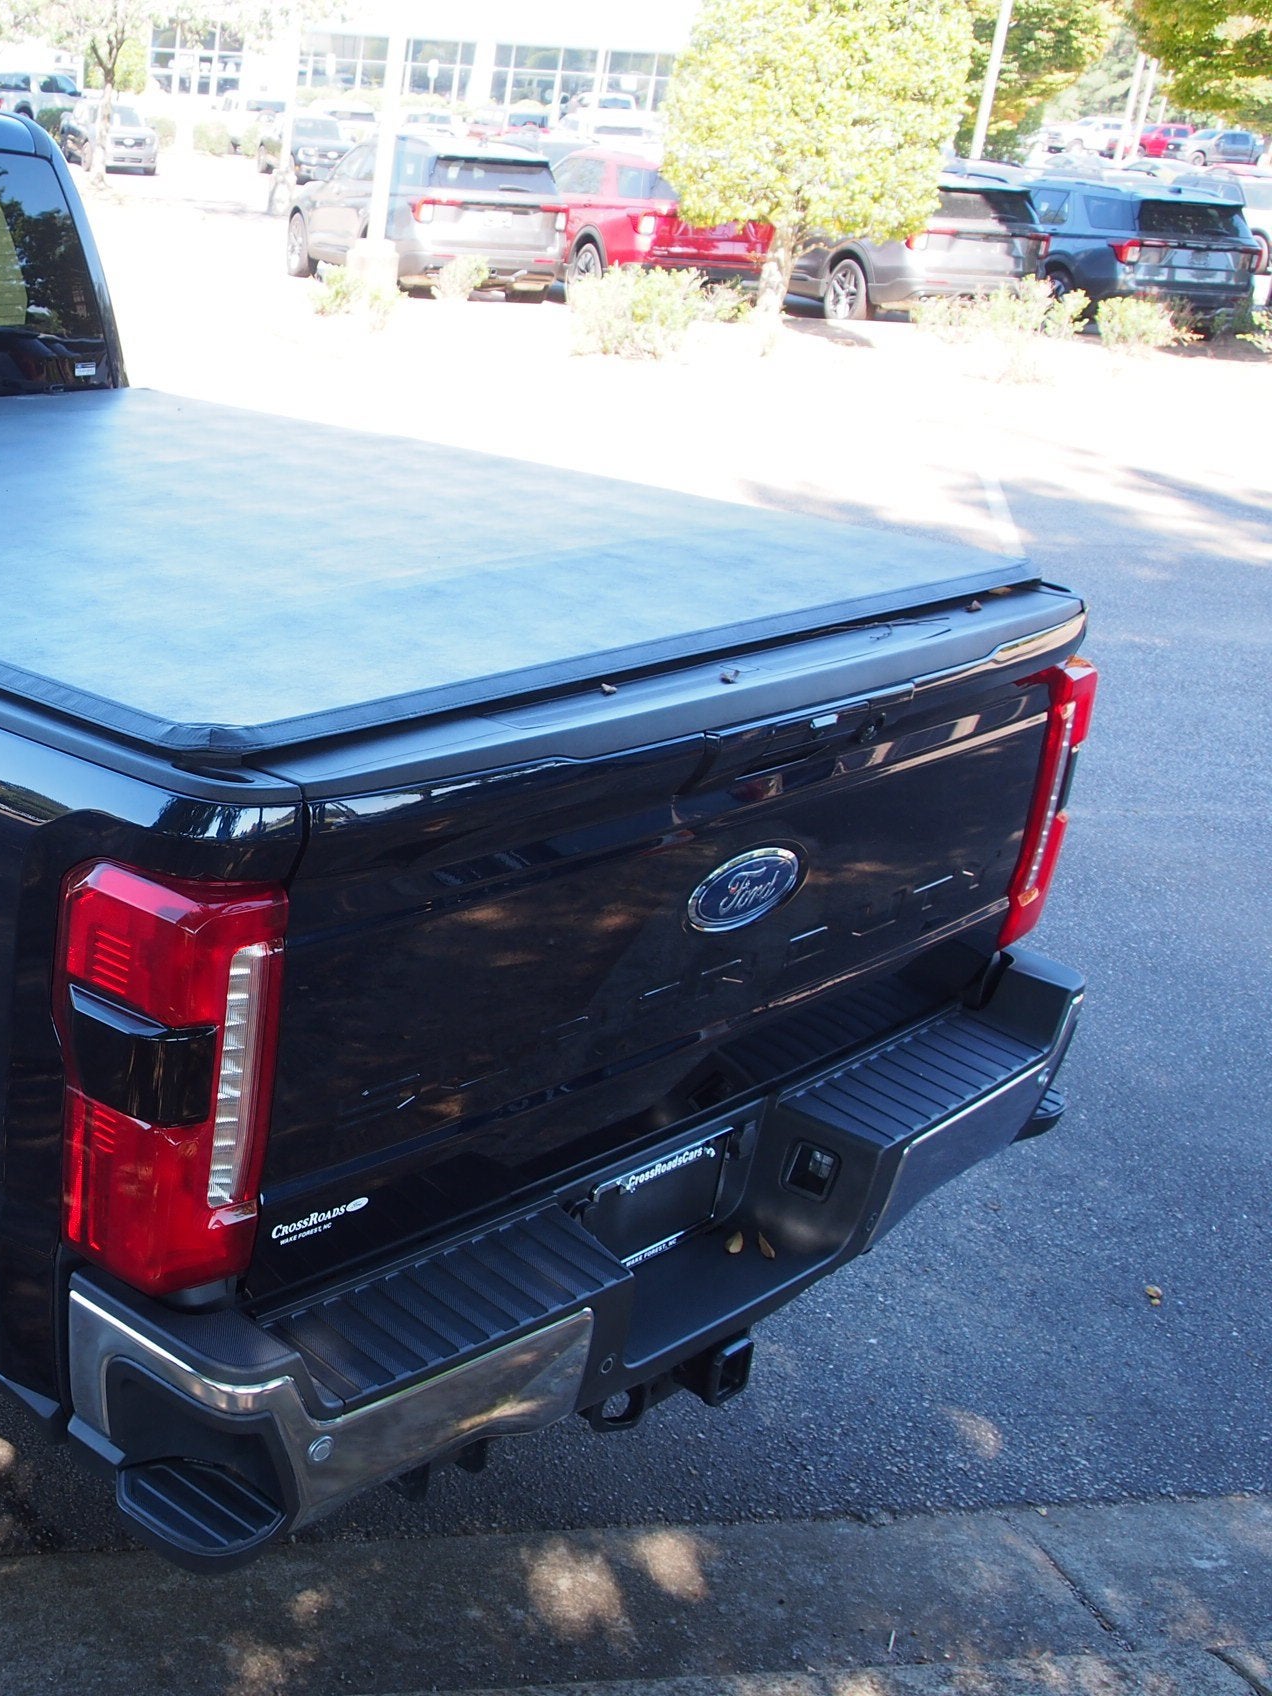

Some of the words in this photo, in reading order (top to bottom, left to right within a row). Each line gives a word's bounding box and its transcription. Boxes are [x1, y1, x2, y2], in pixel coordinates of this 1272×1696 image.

[718, 866, 780, 915] Ford
[628, 1147, 703, 1188] CrossRoadsCars
[280, 1234, 297, 1246] WAKE
[323, 1222, 332, 1231] NC
[625, 1254, 643, 1267] WAKE
